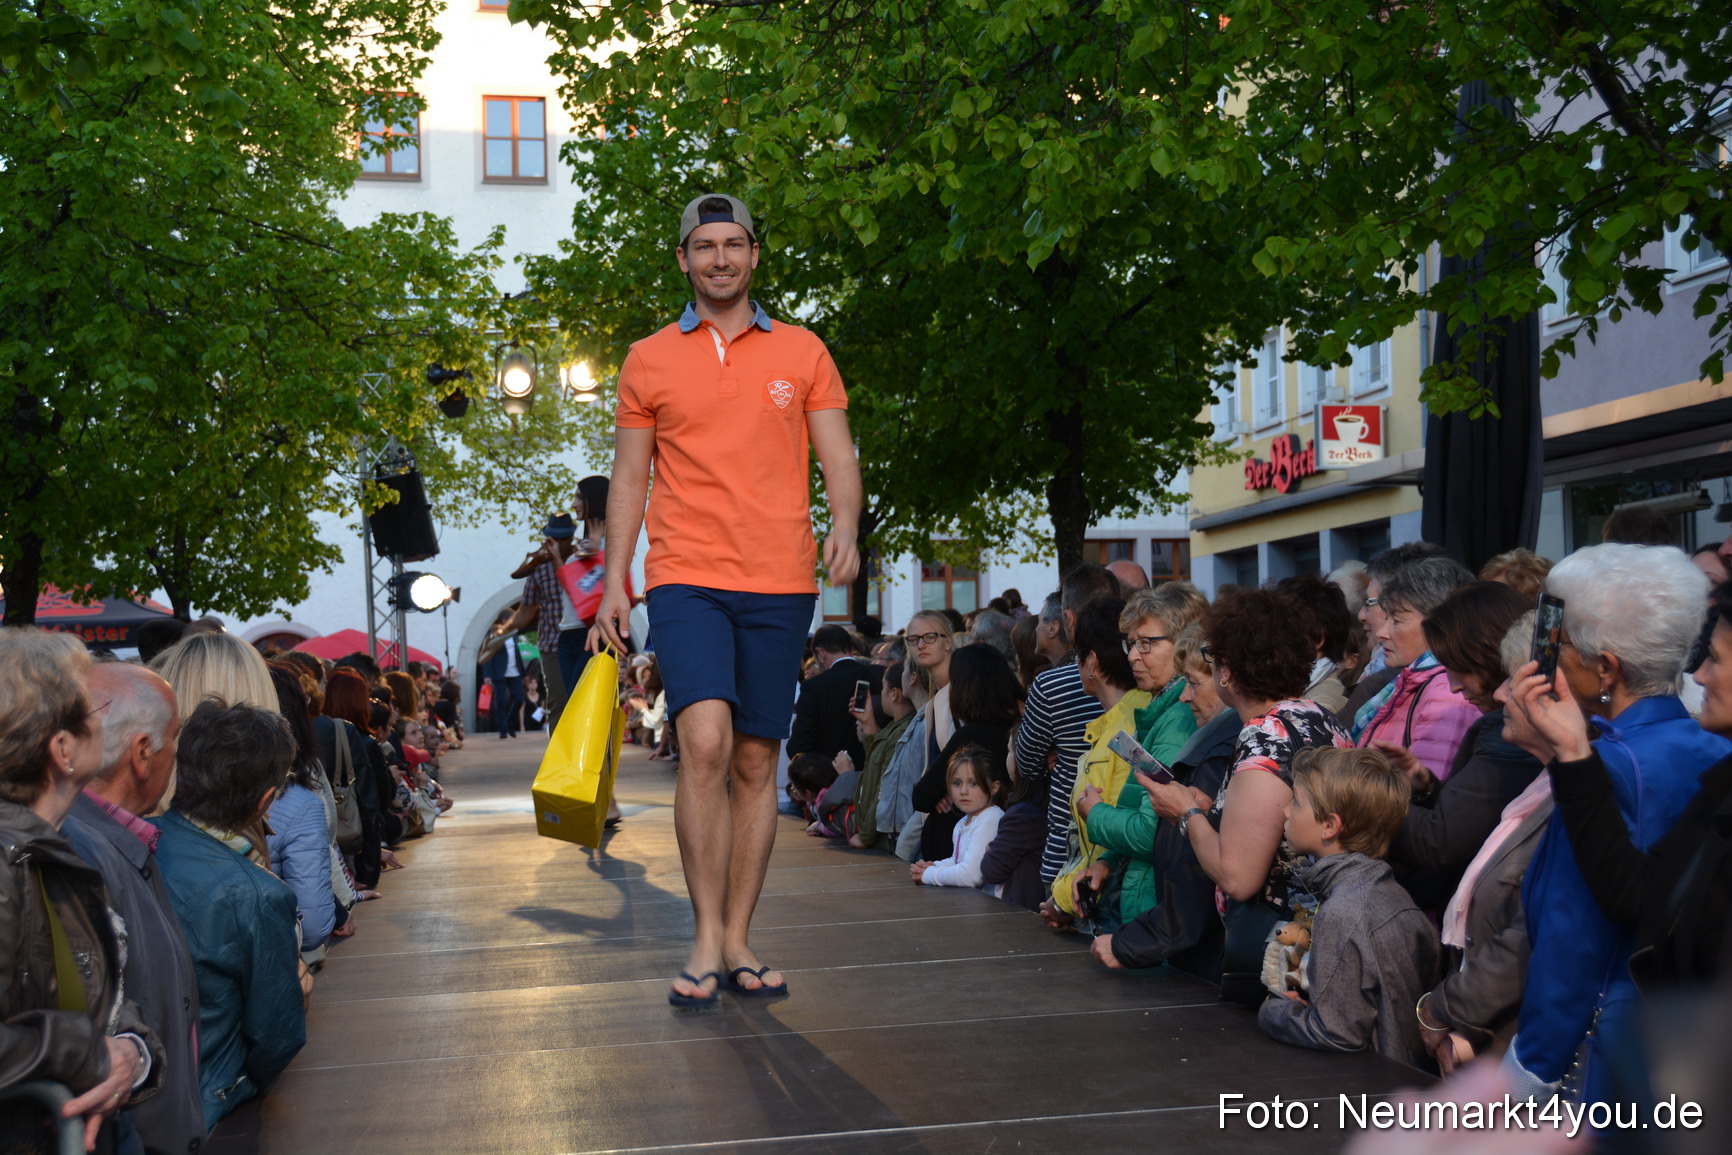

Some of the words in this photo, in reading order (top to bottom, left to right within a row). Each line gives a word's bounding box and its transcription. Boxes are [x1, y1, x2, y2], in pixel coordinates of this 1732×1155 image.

[1244, 458, 1271, 490] Der
[1270, 434, 1316, 494] Beck
[1328, 450, 1344, 459] Der
[1344, 446, 1373, 461] Beck
